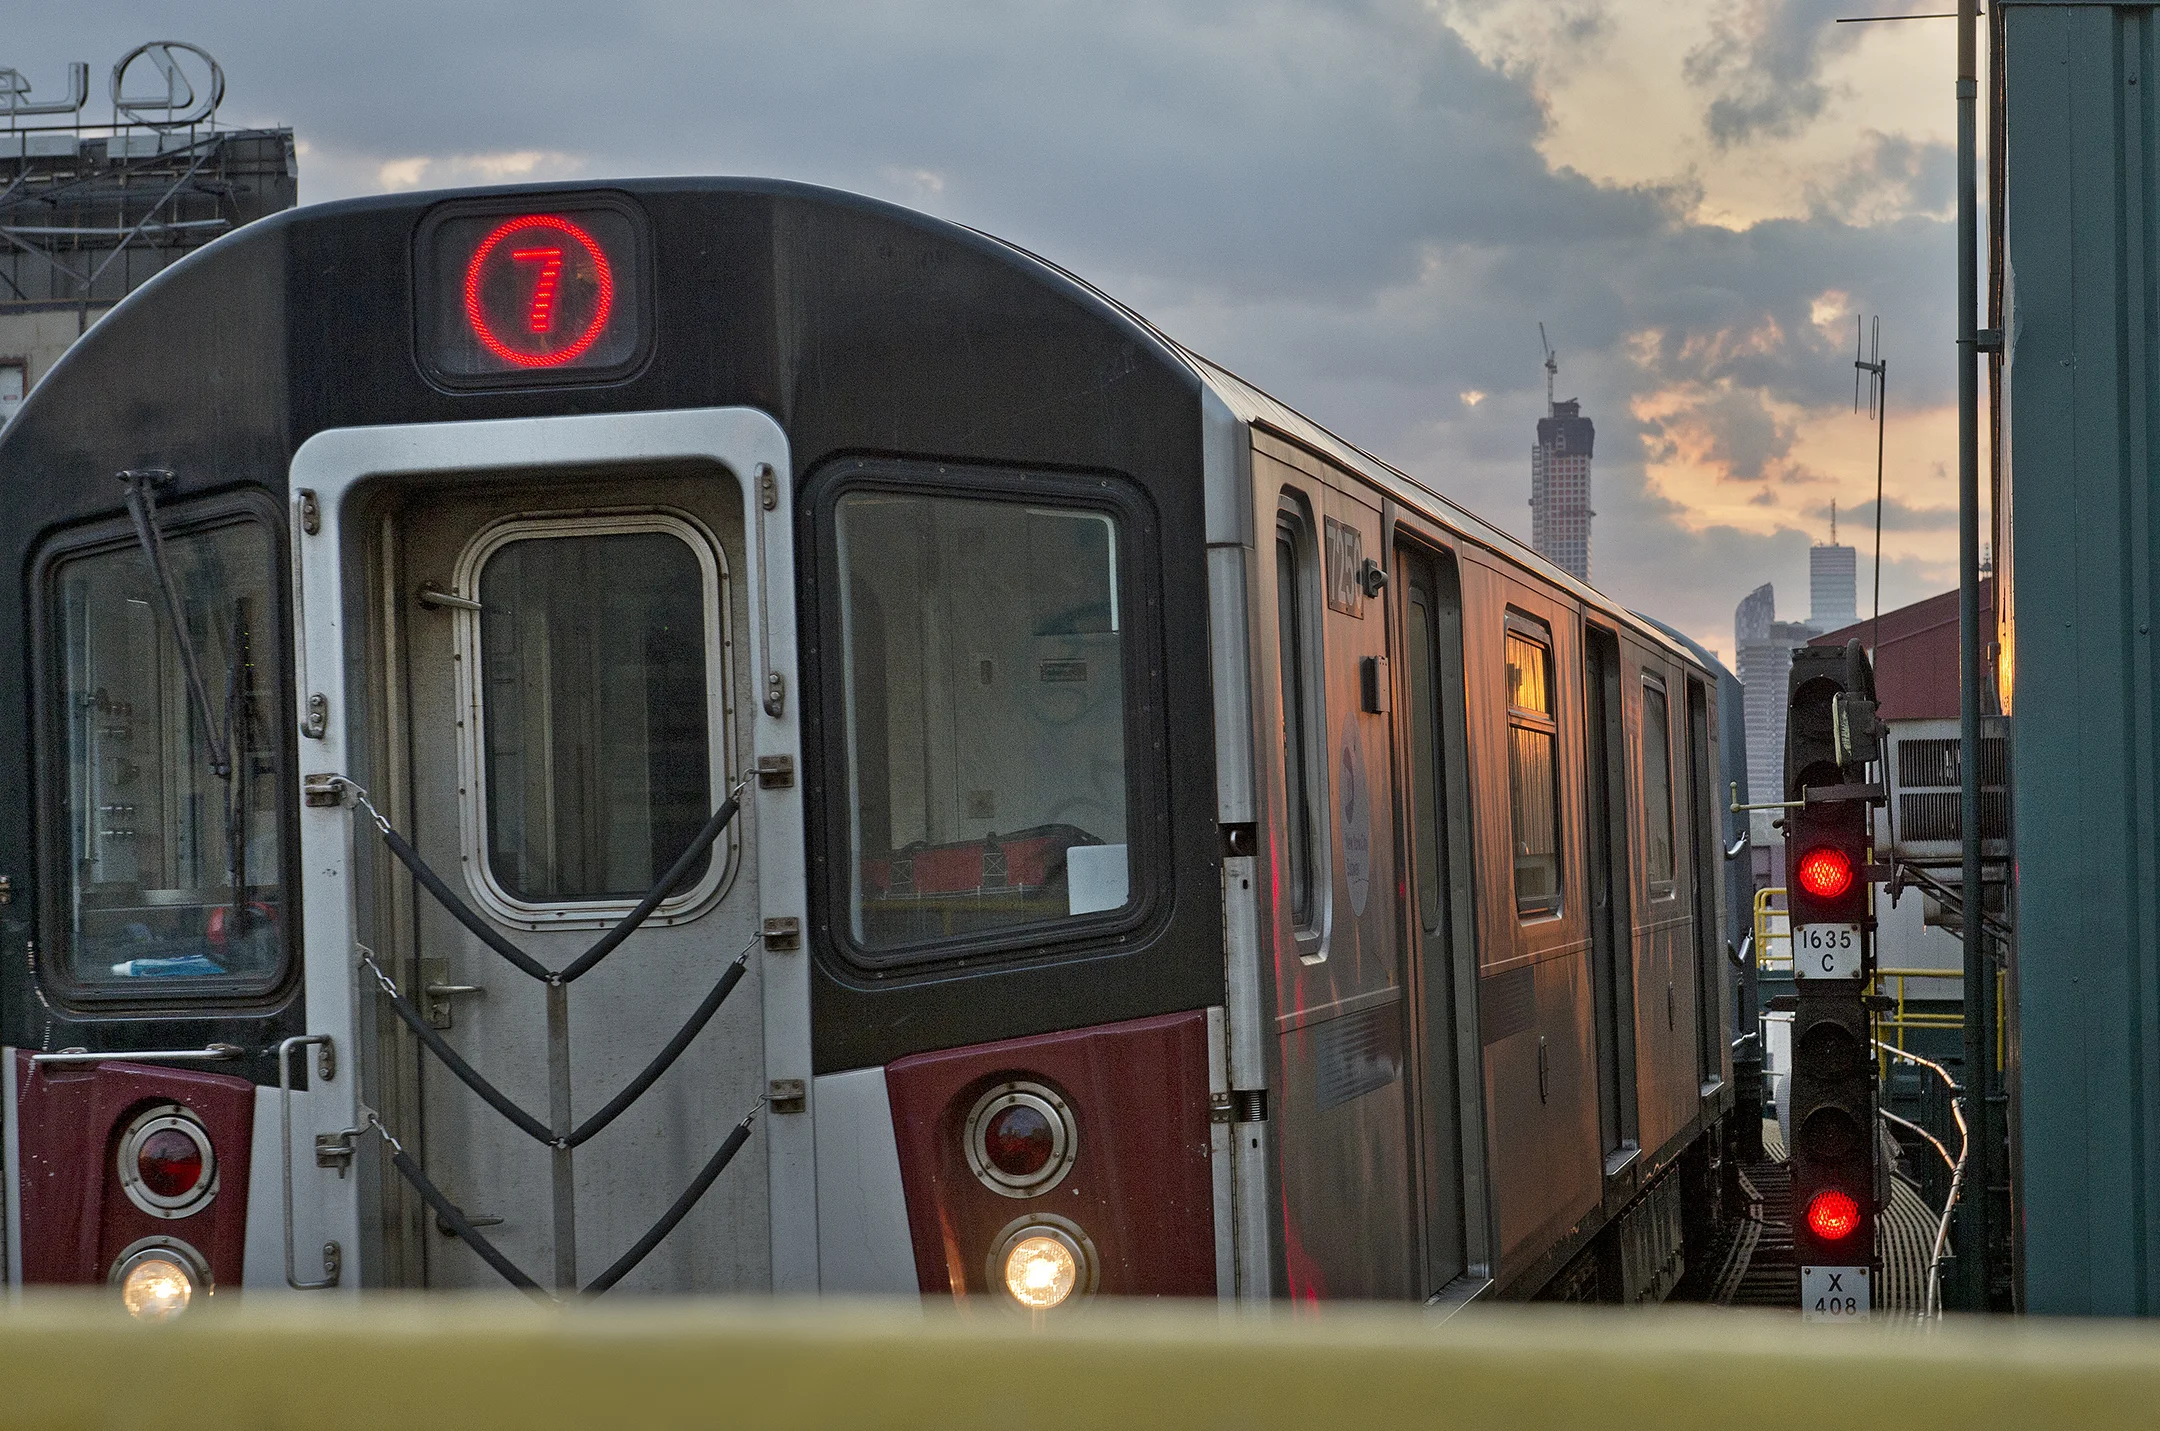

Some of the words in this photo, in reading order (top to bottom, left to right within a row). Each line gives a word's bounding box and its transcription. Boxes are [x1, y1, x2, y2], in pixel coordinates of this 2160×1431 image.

[511, 249, 563, 332] 7
[1803, 930, 1851, 949] 1635
[1821, 953, 1834, 972] C
[1828, 1273, 1843, 1292] X
[1815, 1297, 1856, 1316] 408
